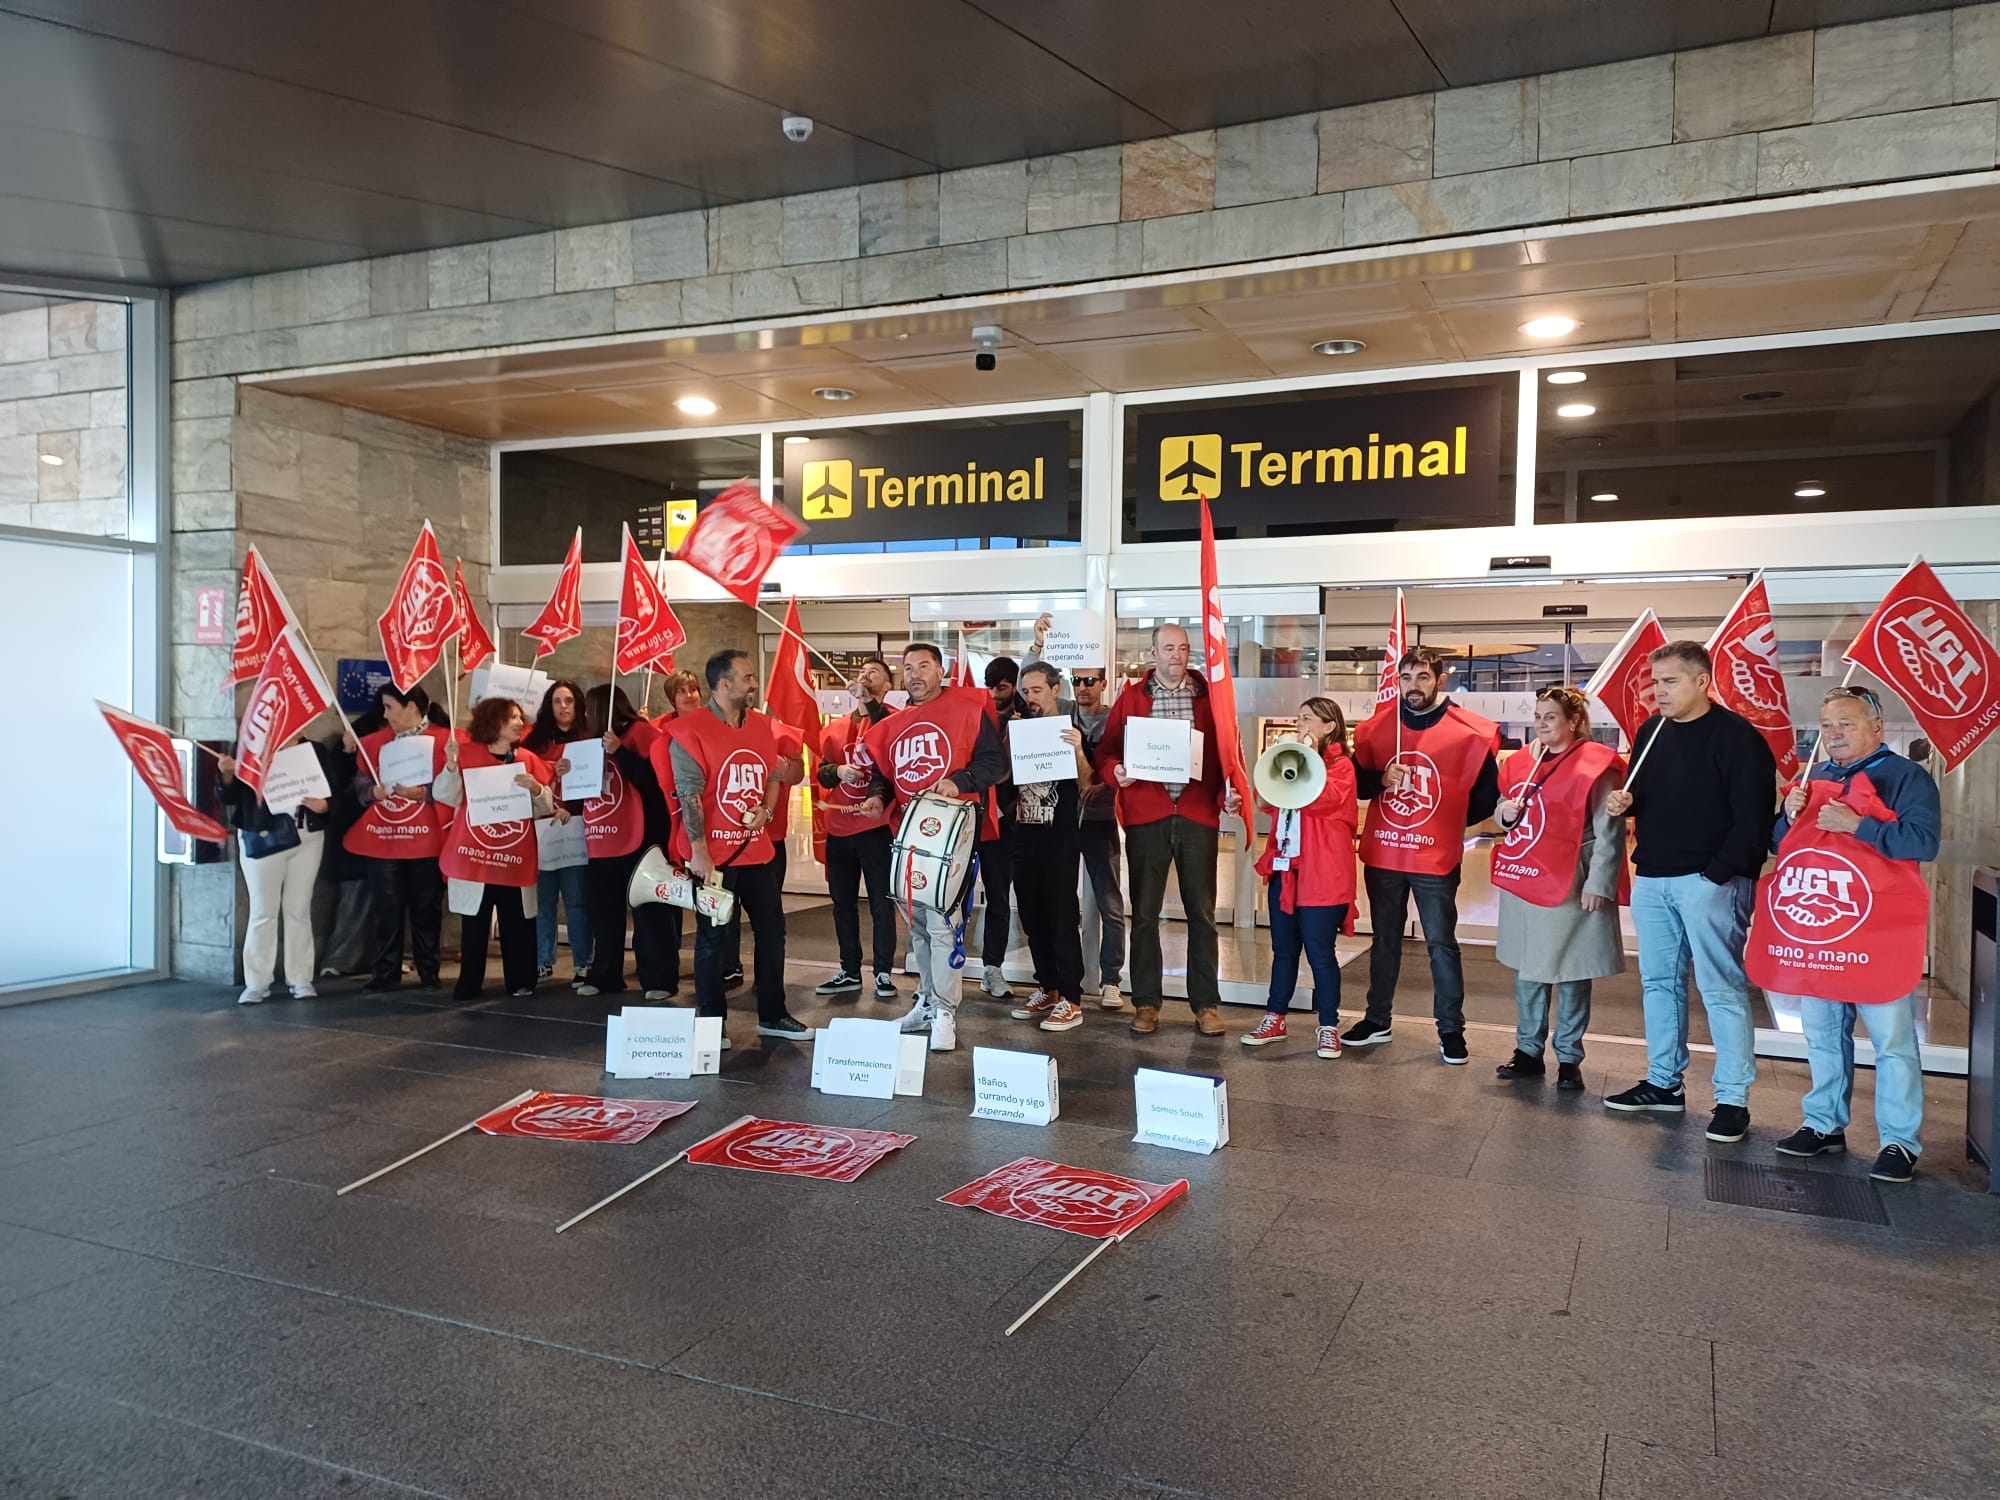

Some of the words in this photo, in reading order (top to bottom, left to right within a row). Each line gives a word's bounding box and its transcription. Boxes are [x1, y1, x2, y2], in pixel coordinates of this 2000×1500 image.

[1231, 426, 1467, 488] Terminal
[858, 457, 1044, 509] Terminal
[625, 627, 673, 658] www.ugt.es
[1085, 642, 1099, 650] sigo
[1909, 606, 1982, 689] UGT
[1047, 653, 1084, 661] esperando
[895, 731, 940, 767] UGT
[1146, 742, 1171, 751] South
[1013, 749, 1072, 761] Transformaciones
[1034, 761, 1053, 771] YA!!!
[726, 763, 764, 794] UGT
[367, 823, 393, 834] mano
[397, 825, 429, 834] mano
[590, 825, 618, 834] mano
[711, 829, 740, 840] mano
[1405, 832, 1434, 846] mano
[457, 845, 485, 860] mano
[493, 853, 523, 865] mano
[1507, 863, 1539, 877] mano
[1778, 866, 1854, 902] UGT
[1808, 952, 1814, 960] a
[1818, 950, 1869, 964] mano
[1779, 958, 1792, 966] Por
[1793, 960, 1806, 968] tus
[1807, 962, 1845, 972] derechos
[634, 1034, 686, 1044] conciliación
[631, 1050, 683, 1060] perentorias
[828, 1056, 892, 1070] Transformaciones
[849, 1072, 869, 1083] YA!!!
[978, 1076, 1008, 1088] 18años
[978, 1091, 1017, 1104] currando
[1019, 1097, 1025, 1107] y
[1026, 1098, 1045, 1109] sigo
[977, 1106, 1025, 1119] esperando
[1151, 1103, 1178, 1116] Somos
[1179, 1108, 1204, 1120] South
[750, 1130, 846, 1154] UGT
[1144, 1129, 1170, 1141] Somos
[1036, 1179, 1140, 1210] UGT
